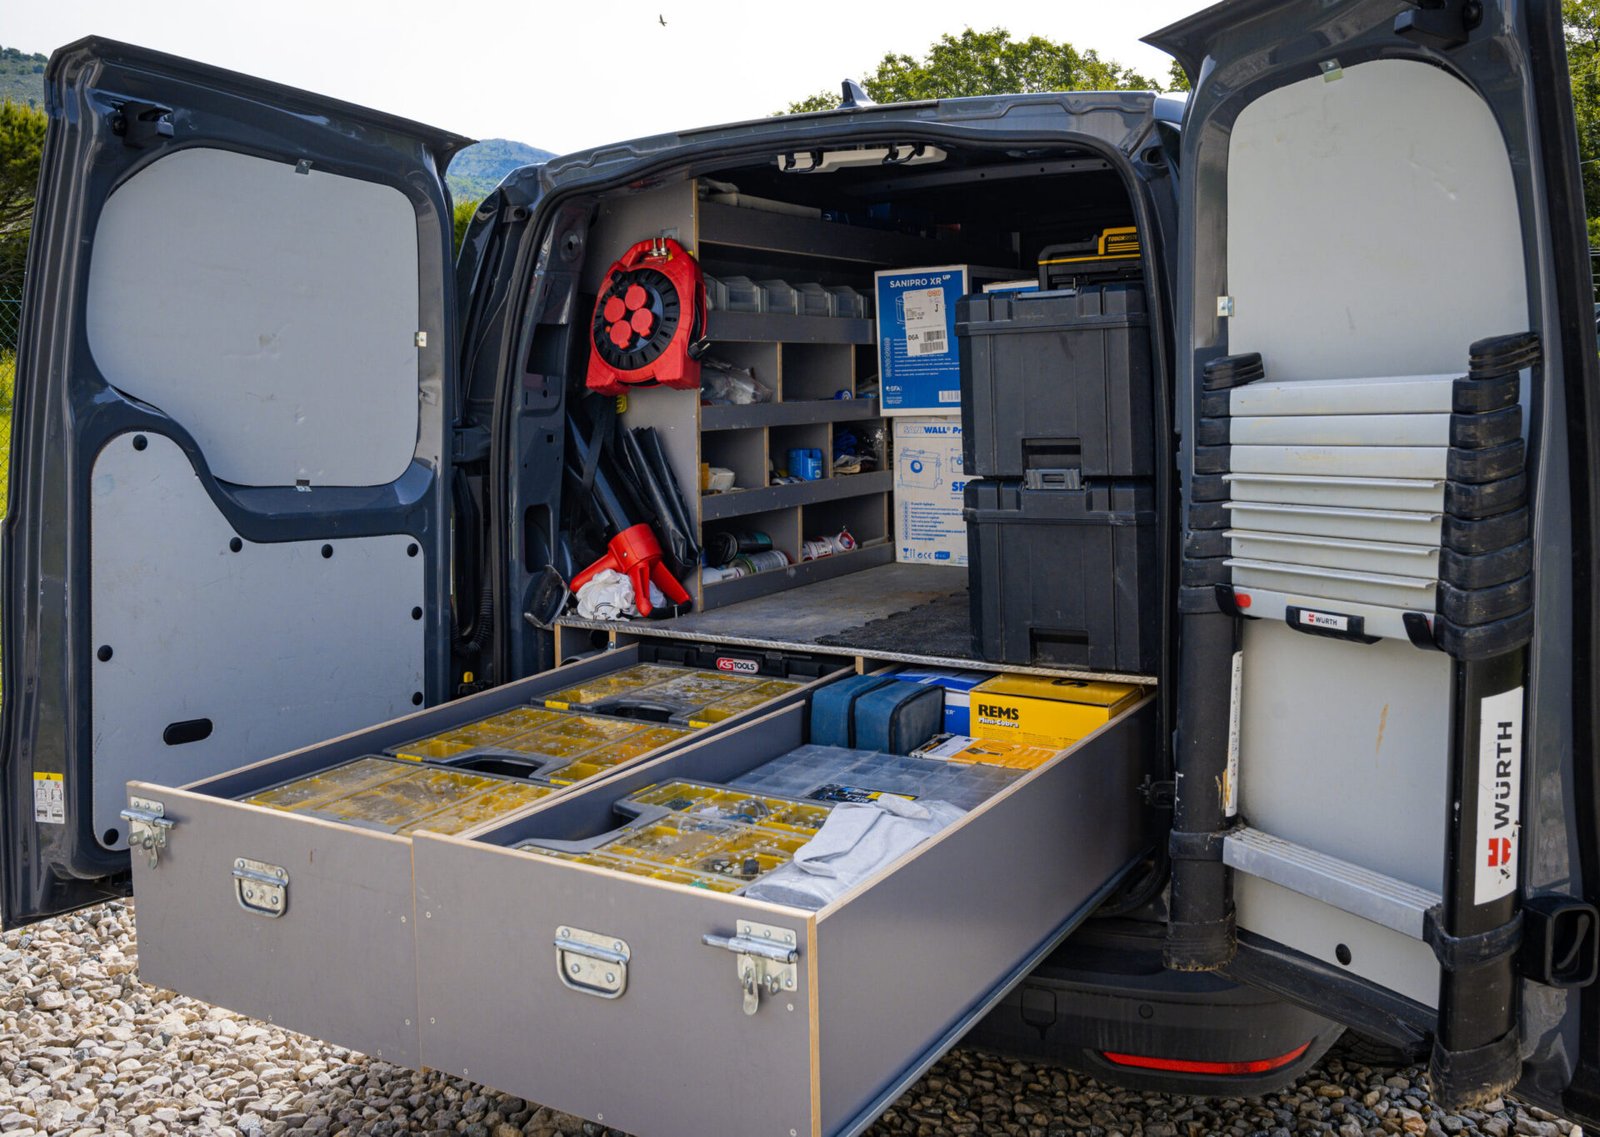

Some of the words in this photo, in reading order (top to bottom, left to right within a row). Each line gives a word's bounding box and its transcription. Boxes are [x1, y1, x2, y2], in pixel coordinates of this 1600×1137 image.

[890, 279, 928, 288] SANIPRO
[930, 277, 942, 286] XR
[952, 426, 963, 434] Pr
[951, 481, 966, 492] SF
[719, 659, 733, 669] KS
[733, 662, 755, 671] TOOLS
[978, 704, 1019, 720] REMS
[978, 717, 1019, 729] Mini-Cobra
[1494, 721, 1513, 830] WÜRTH
